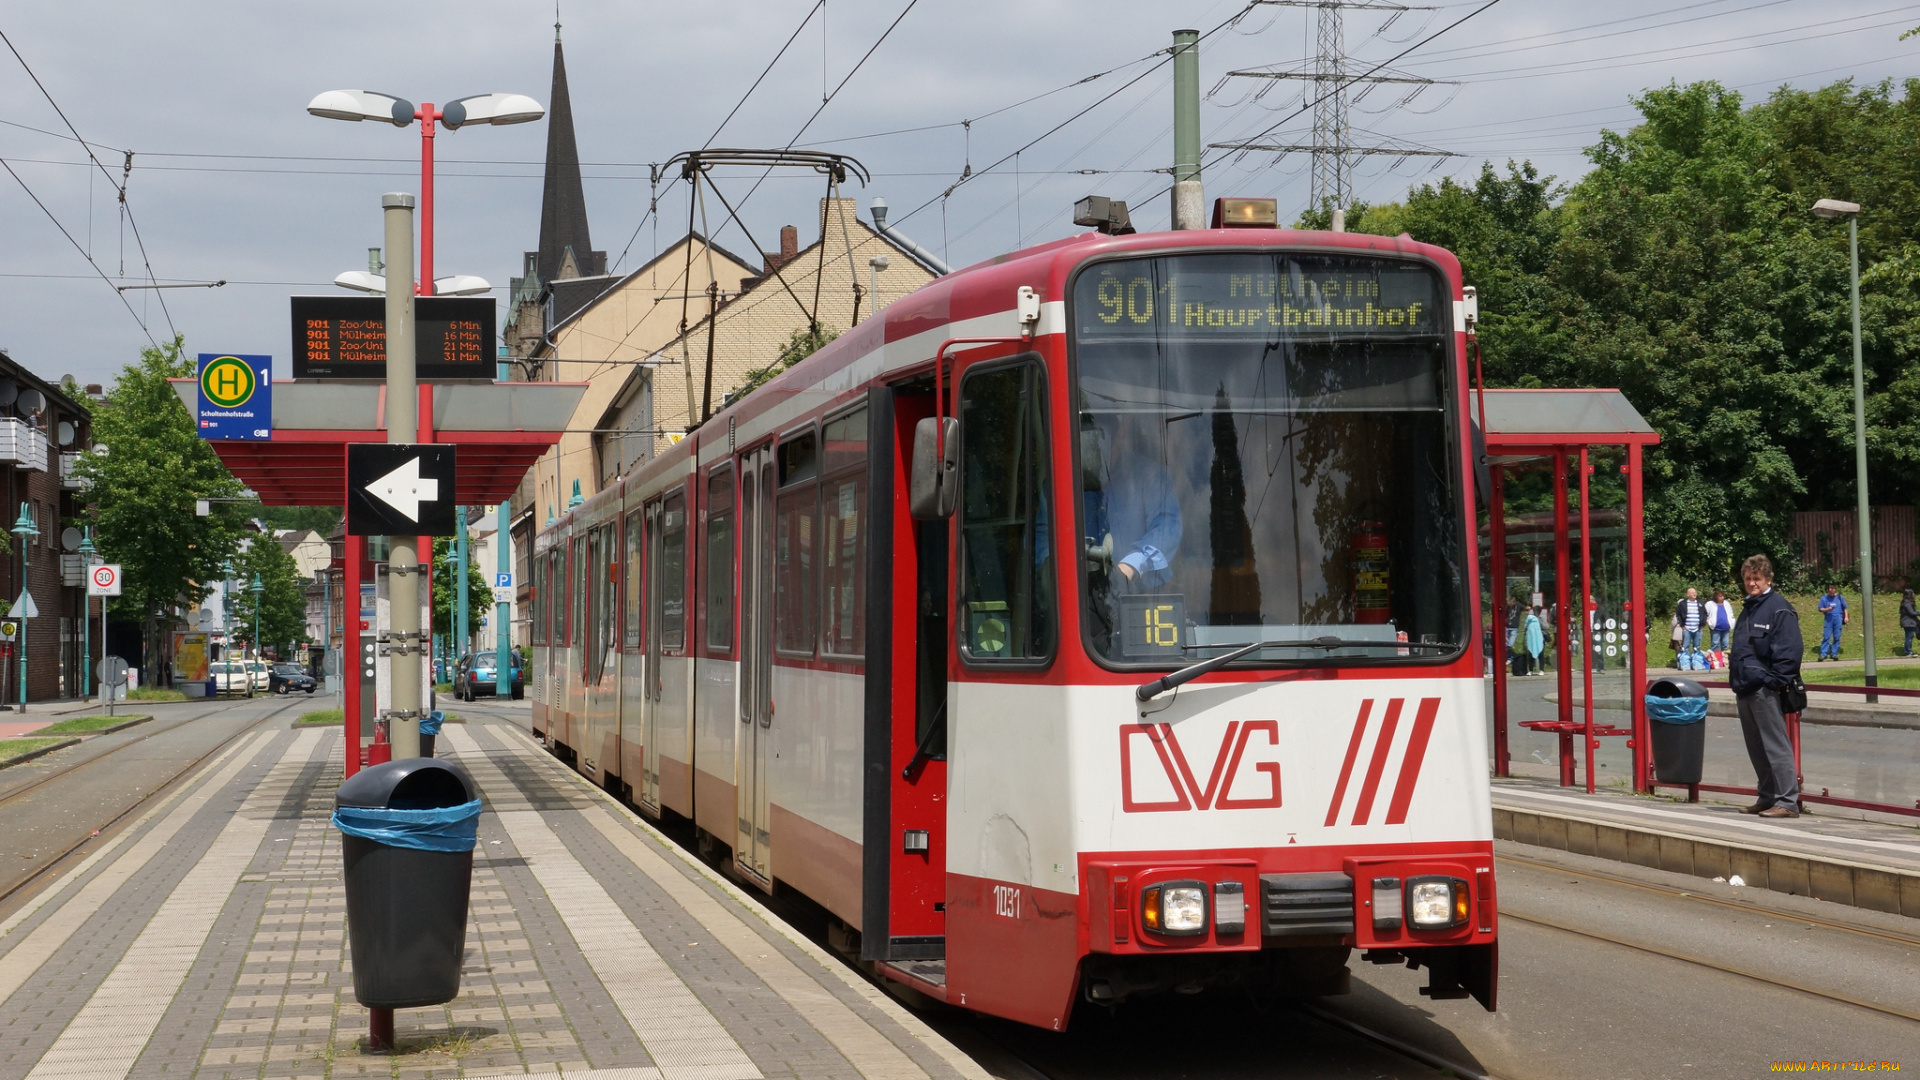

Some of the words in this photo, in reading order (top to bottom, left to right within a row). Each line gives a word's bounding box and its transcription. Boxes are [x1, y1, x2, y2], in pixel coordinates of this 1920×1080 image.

[1230, 274, 1379, 297] Mülheim
[1098, 277, 1177, 323] 901
[1185, 302, 1422, 326] Hauptbahnhof
[307, 320, 330, 329] 901
[340, 320, 383, 329] Zoo/Uni
[450, 321, 457, 329] 6
[460, 321, 482, 329] Min.
[307, 330, 330, 339] 901
[445, 331, 457, 340] 16
[460, 331, 482, 340] Min.
[308, 341, 330, 350] 901
[340, 341, 384, 350] Zoo/Uni
[444, 342, 457, 350] 21
[460, 342, 482, 350] Min.
[308, 352, 330, 360] 901
[444, 352, 457, 361] 31
[460, 352, 482, 361] Min.
[218, 369, 238, 395] H
[260, 368, 268, 386] 1
[201, 410, 254, 418] Scholtenhofstraße
[98, 572, 110, 582] 30
[500, 575, 509, 587] P
[1145, 605, 1178, 646] 16
[1119, 720, 1282, 813] DVG
[993, 885, 1020, 919] 1031
[1054, 1017, 1059, 1030] 2
